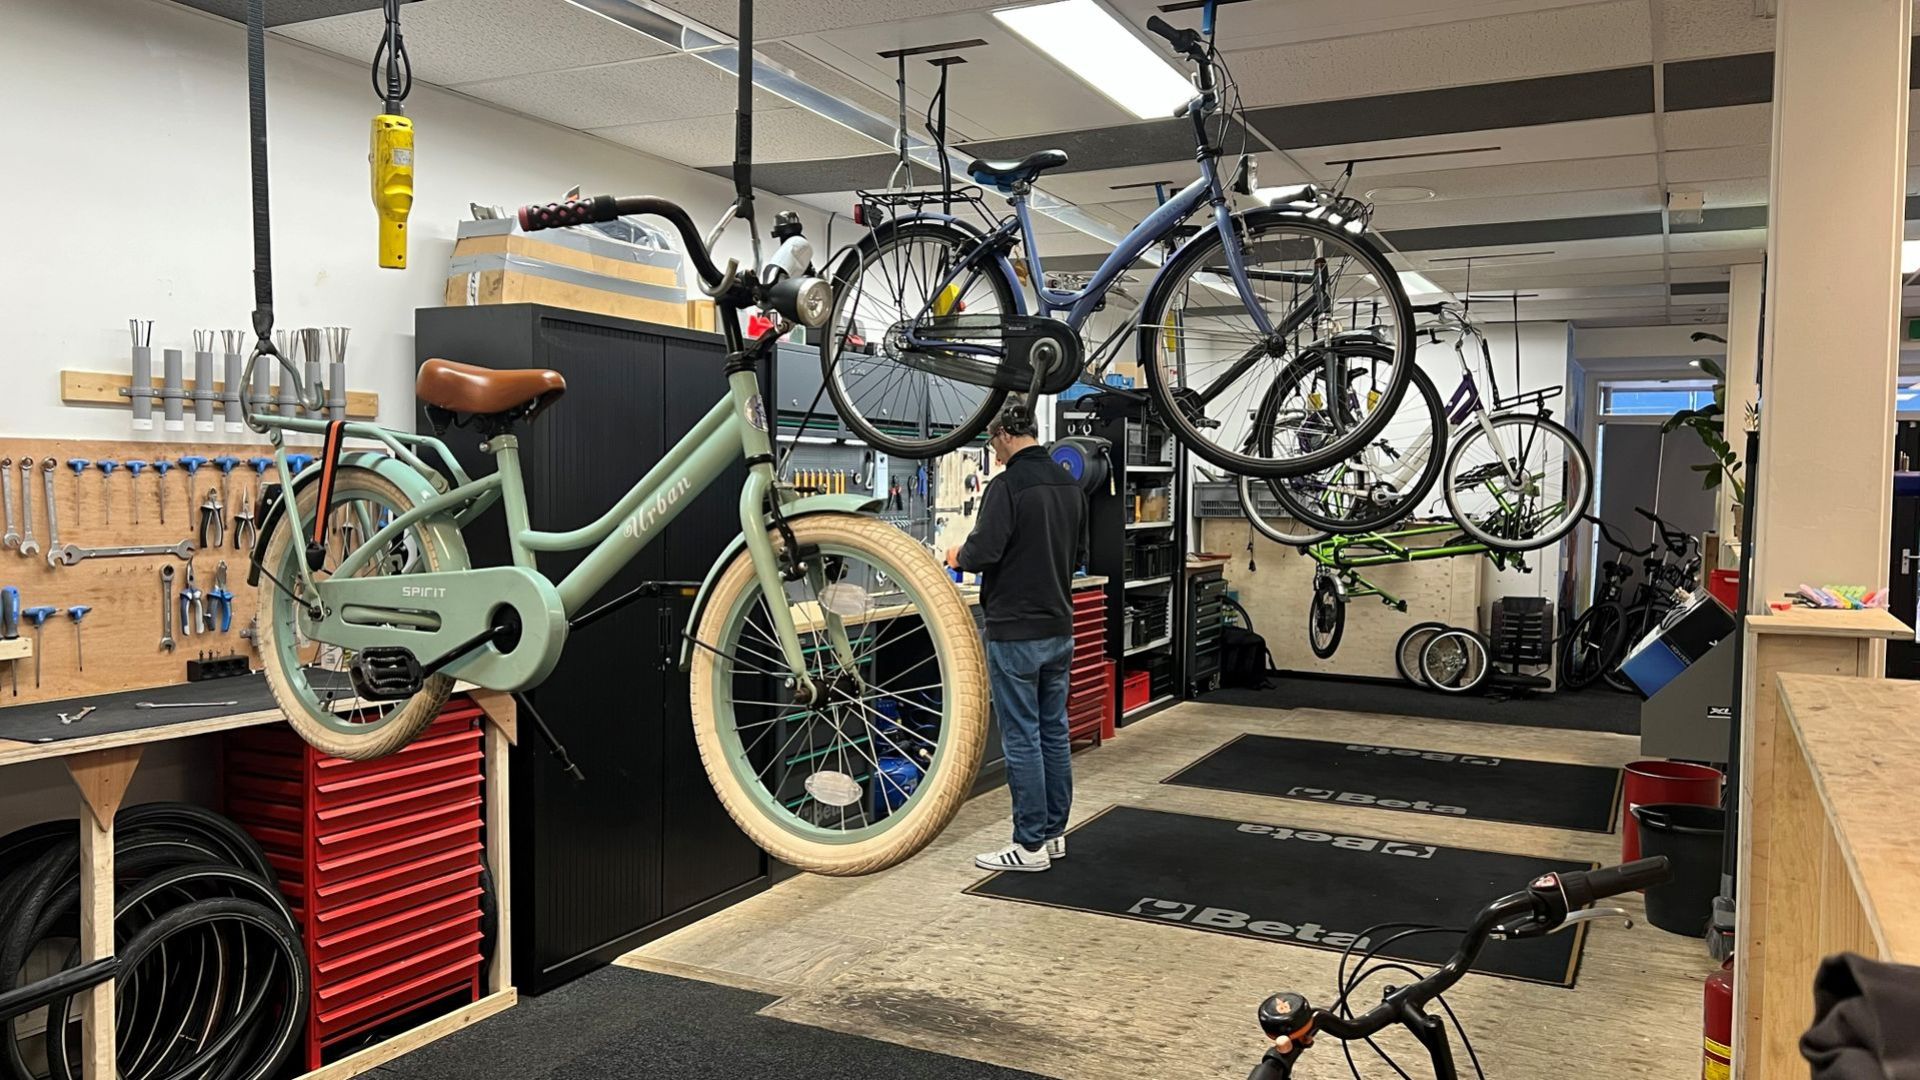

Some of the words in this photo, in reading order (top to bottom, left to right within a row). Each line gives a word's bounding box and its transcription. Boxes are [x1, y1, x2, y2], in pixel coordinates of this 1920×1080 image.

[623, 477, 692, 538] Urban
[402, 586, 446, 598] SPIRIT
[1346, 745, 1455, 762] Beta
[1335, 792, 1467, 815] Beta
[1237, 823, 1379, 851] Beta
[1191, 907, 1371, 950] Beta
